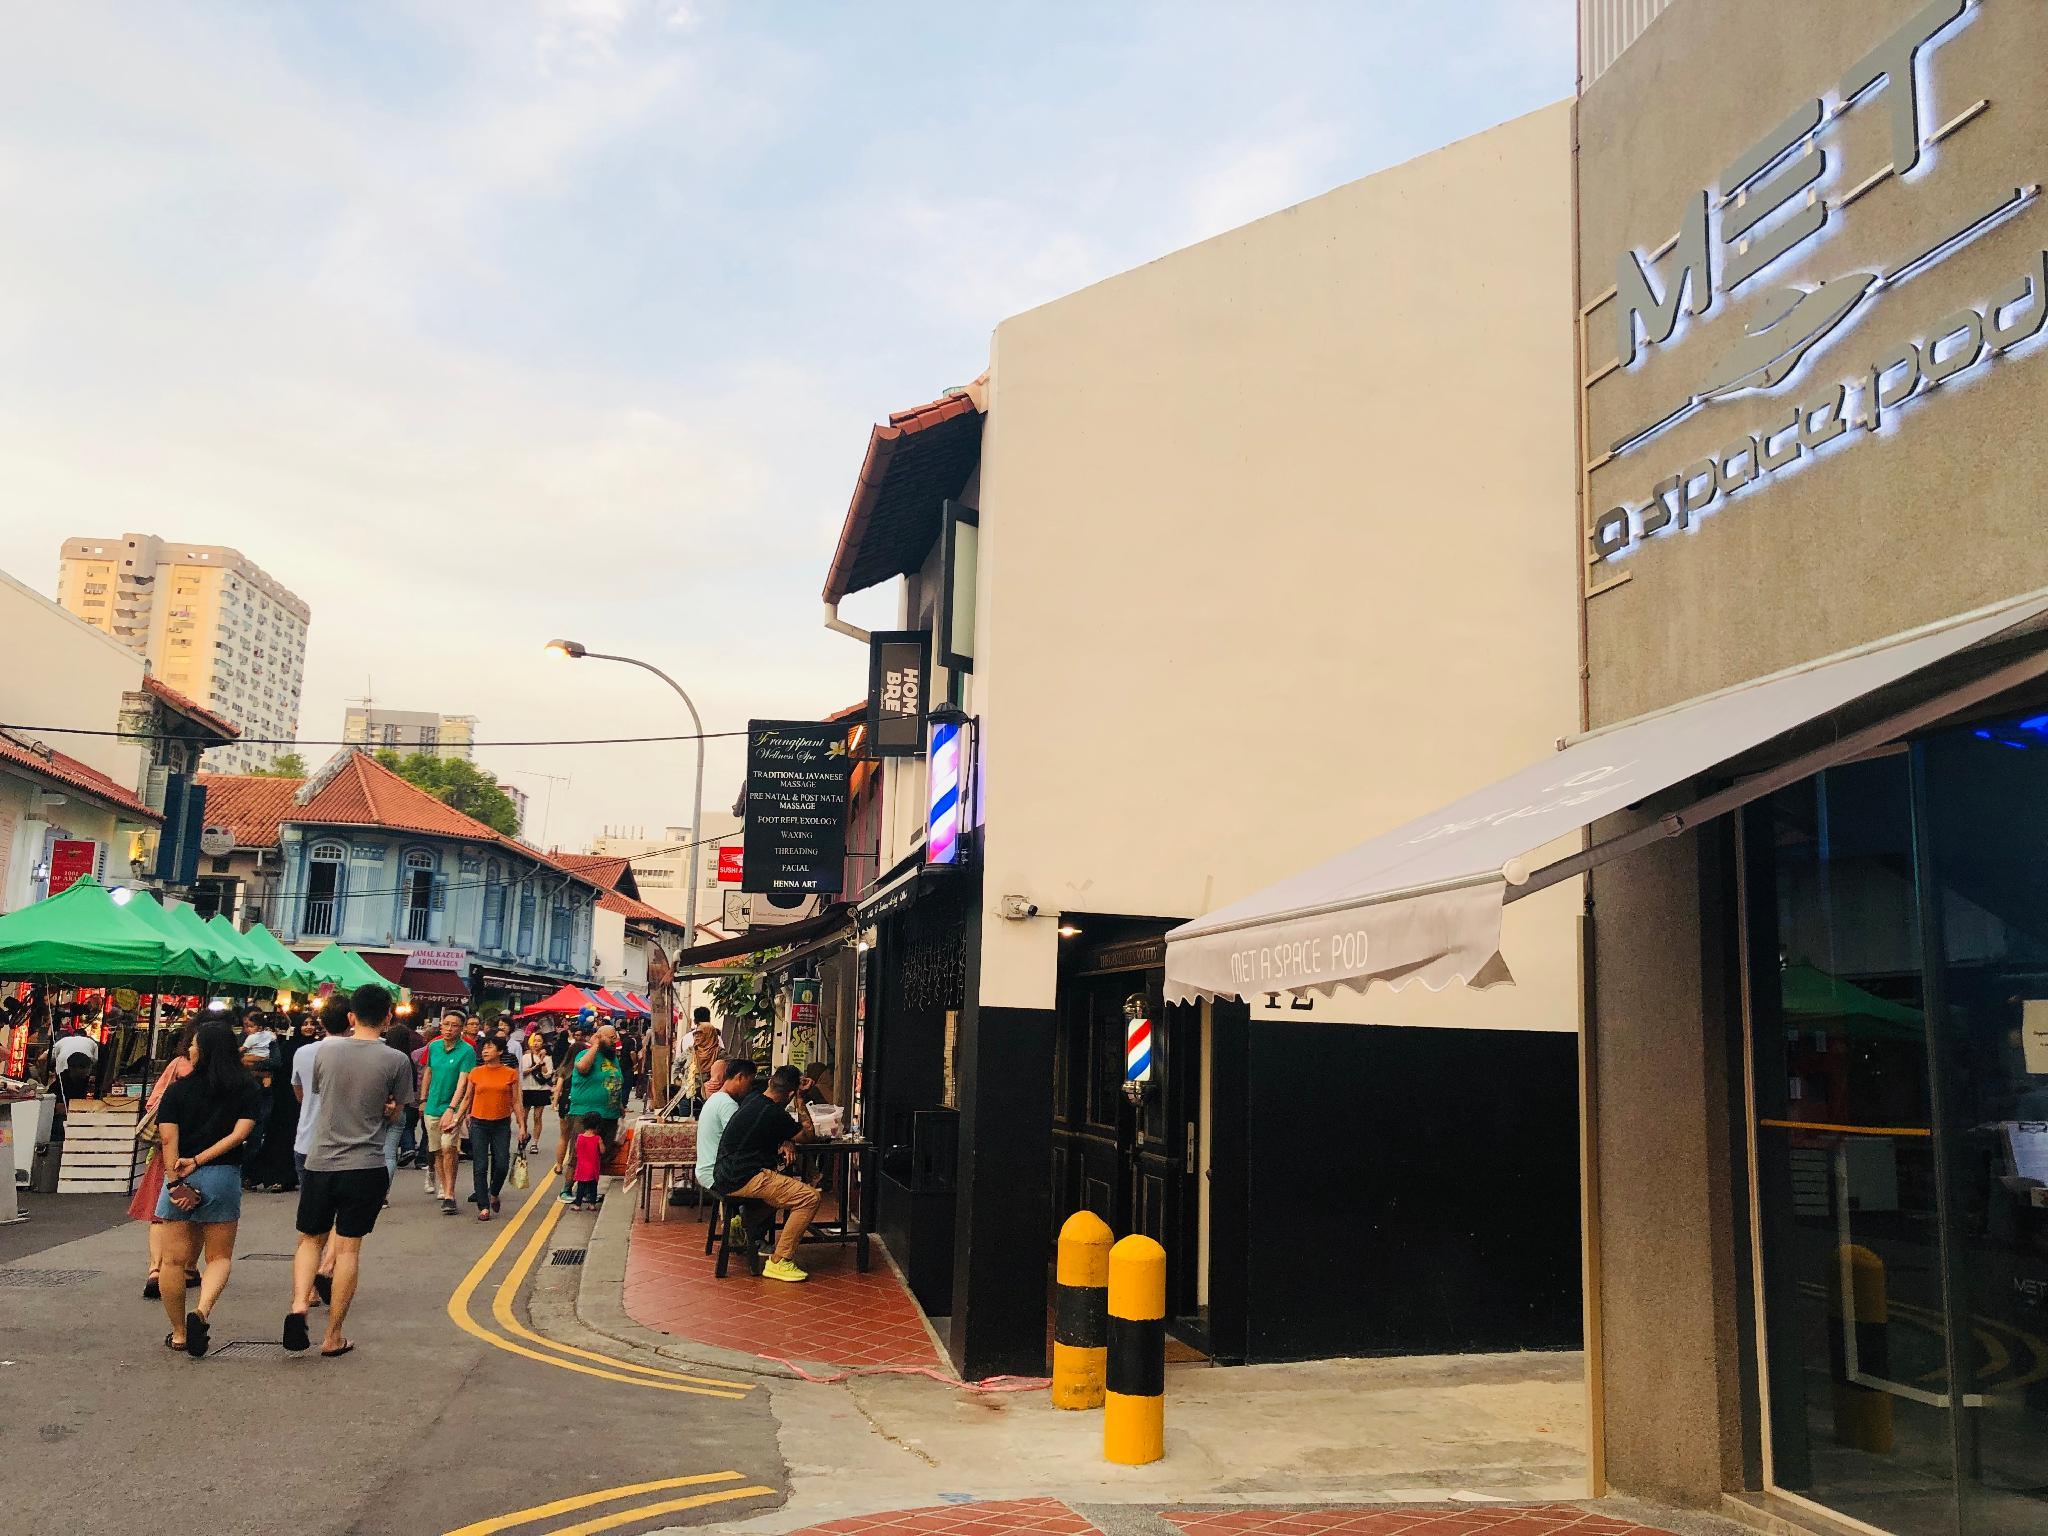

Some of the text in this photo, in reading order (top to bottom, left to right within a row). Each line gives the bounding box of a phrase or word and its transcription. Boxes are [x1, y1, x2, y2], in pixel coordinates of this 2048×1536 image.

[1616, 0, 1968, 367] MET
[1593, 249, 2048, 559] a space pod
[884, 671, 902, 712] BRE
[752, 731, 825, 752] Frangipani
[755, 747, 817, 764] Wellness Spa
[753, 770, 844, 781] TRADITIONAL JAVANESE
[780, 780, 817, 788] MASSAGE
[749, 792, 764, 800] PRE
[765, 793, 791, 801] NATAL
[800, 793, 819, 802] POST
[820, 794, 844, 803] NATAL
[779, 802, 816, 810] MASSAGE
[757, 815, 838, 825] FOOT REFLEXOLOGY
[780, 830, 813, 839] WAXING
[774, 847, 819, 856] THREADING
[719, 866, 738, 874] SUSHI
[781, 864, 810, 872] FACIAL
[773, 879, 818, 889] HENNA ART
[411, 949, 435, 958] JAMAL
[1231, 930, 1368, 984] MET A SPACE POD
[417, 958, 458, 967] AROMATICS
